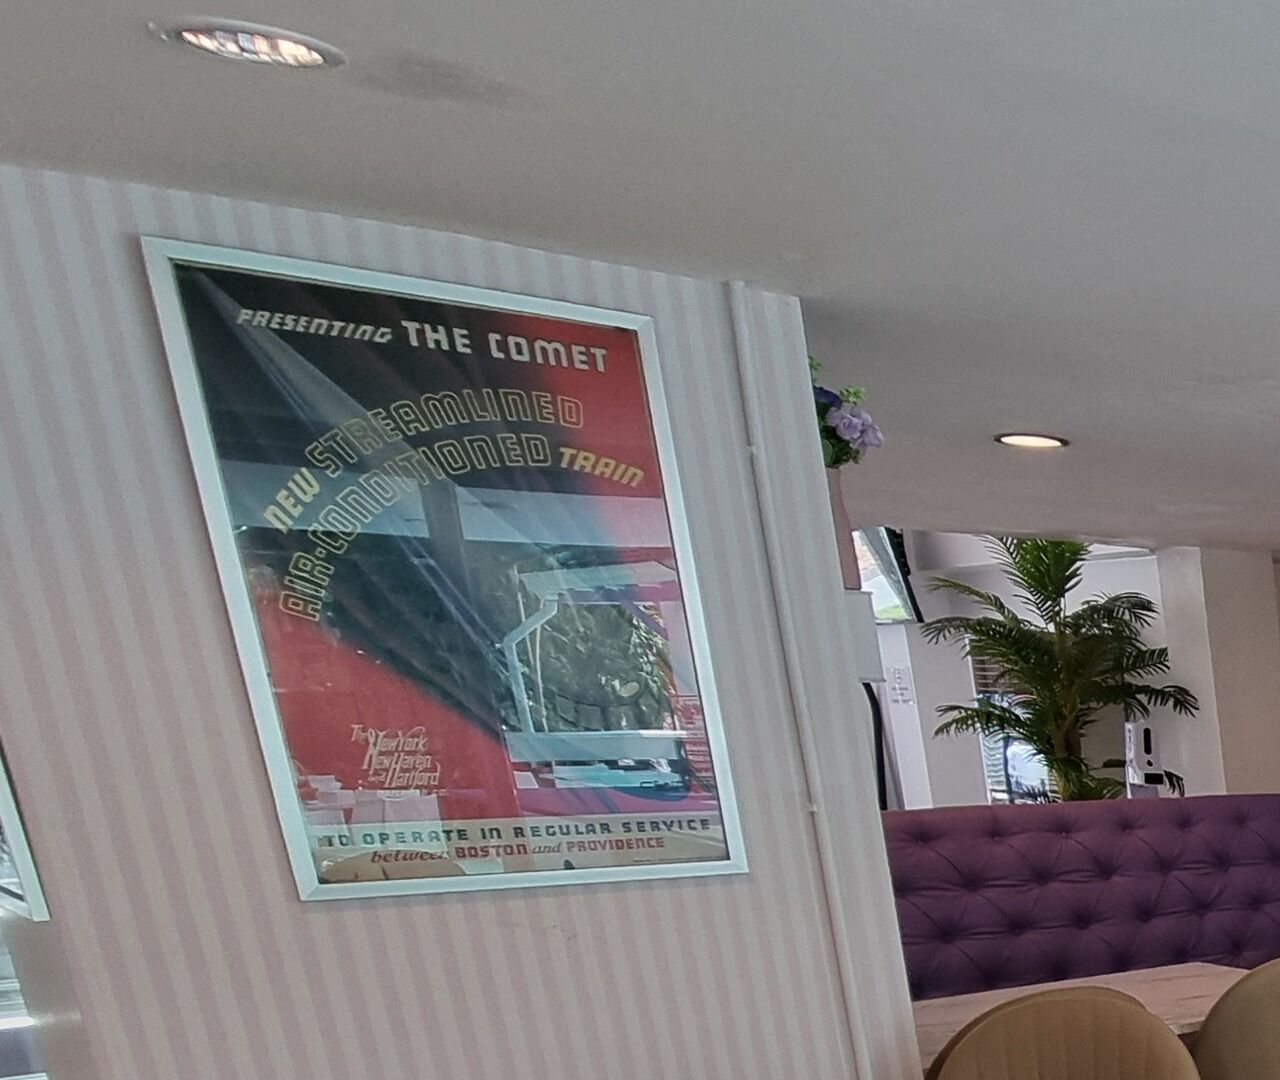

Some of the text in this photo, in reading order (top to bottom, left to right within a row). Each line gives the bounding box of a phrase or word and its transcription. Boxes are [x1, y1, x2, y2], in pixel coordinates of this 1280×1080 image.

[236, 308, 608, 374] PRESENTING THE COMET
[263, 387, 584, 534] NEW STREAMLINED
[279, 433, 645, 622] AIR-CONDITIONED TRAIN
[361, 828, 469, 846] OPERATE
[479, 827, 503, 840] IN
[512, 823, 613, 838] REGULAR
[621, 818, 711, 833] SERVICE
[455, 843, 528, 859] BOSTON
[532, 841, 562, 855] and
[566, 836, 666, 853] PROVIDENCE
